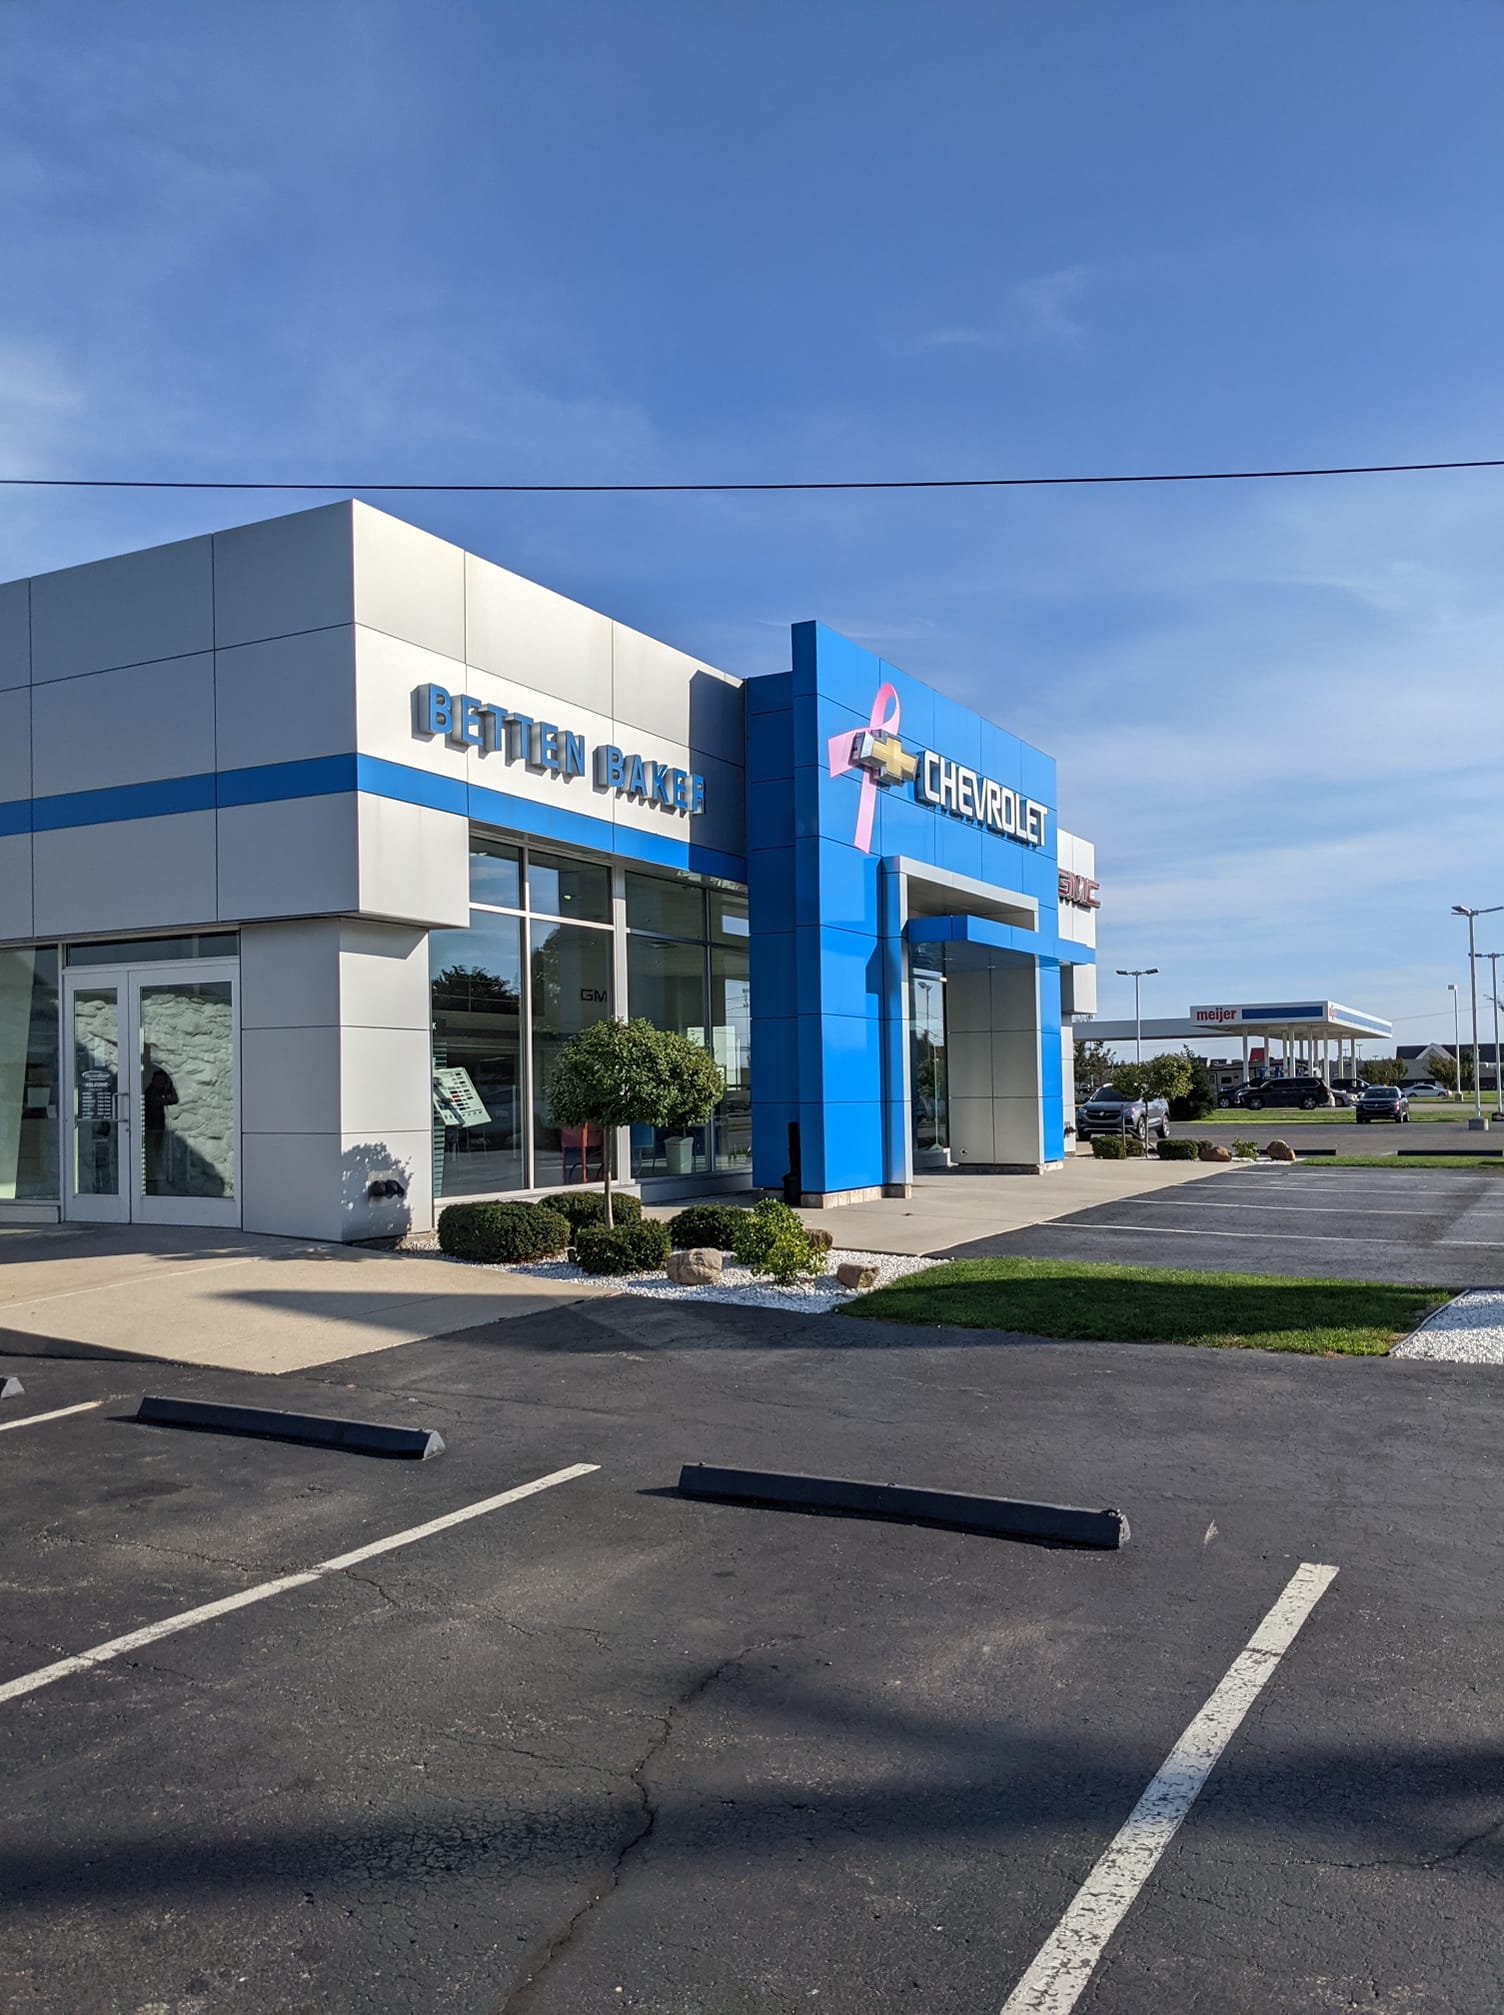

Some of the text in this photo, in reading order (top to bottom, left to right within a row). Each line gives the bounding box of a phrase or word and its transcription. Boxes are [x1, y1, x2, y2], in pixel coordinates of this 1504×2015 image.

[417, 683, 705, 814] BETTEN BAKER
[921, 749, 1048, 847] CHEVROLET
[1196, 1007, 1237, 1023] meijer
